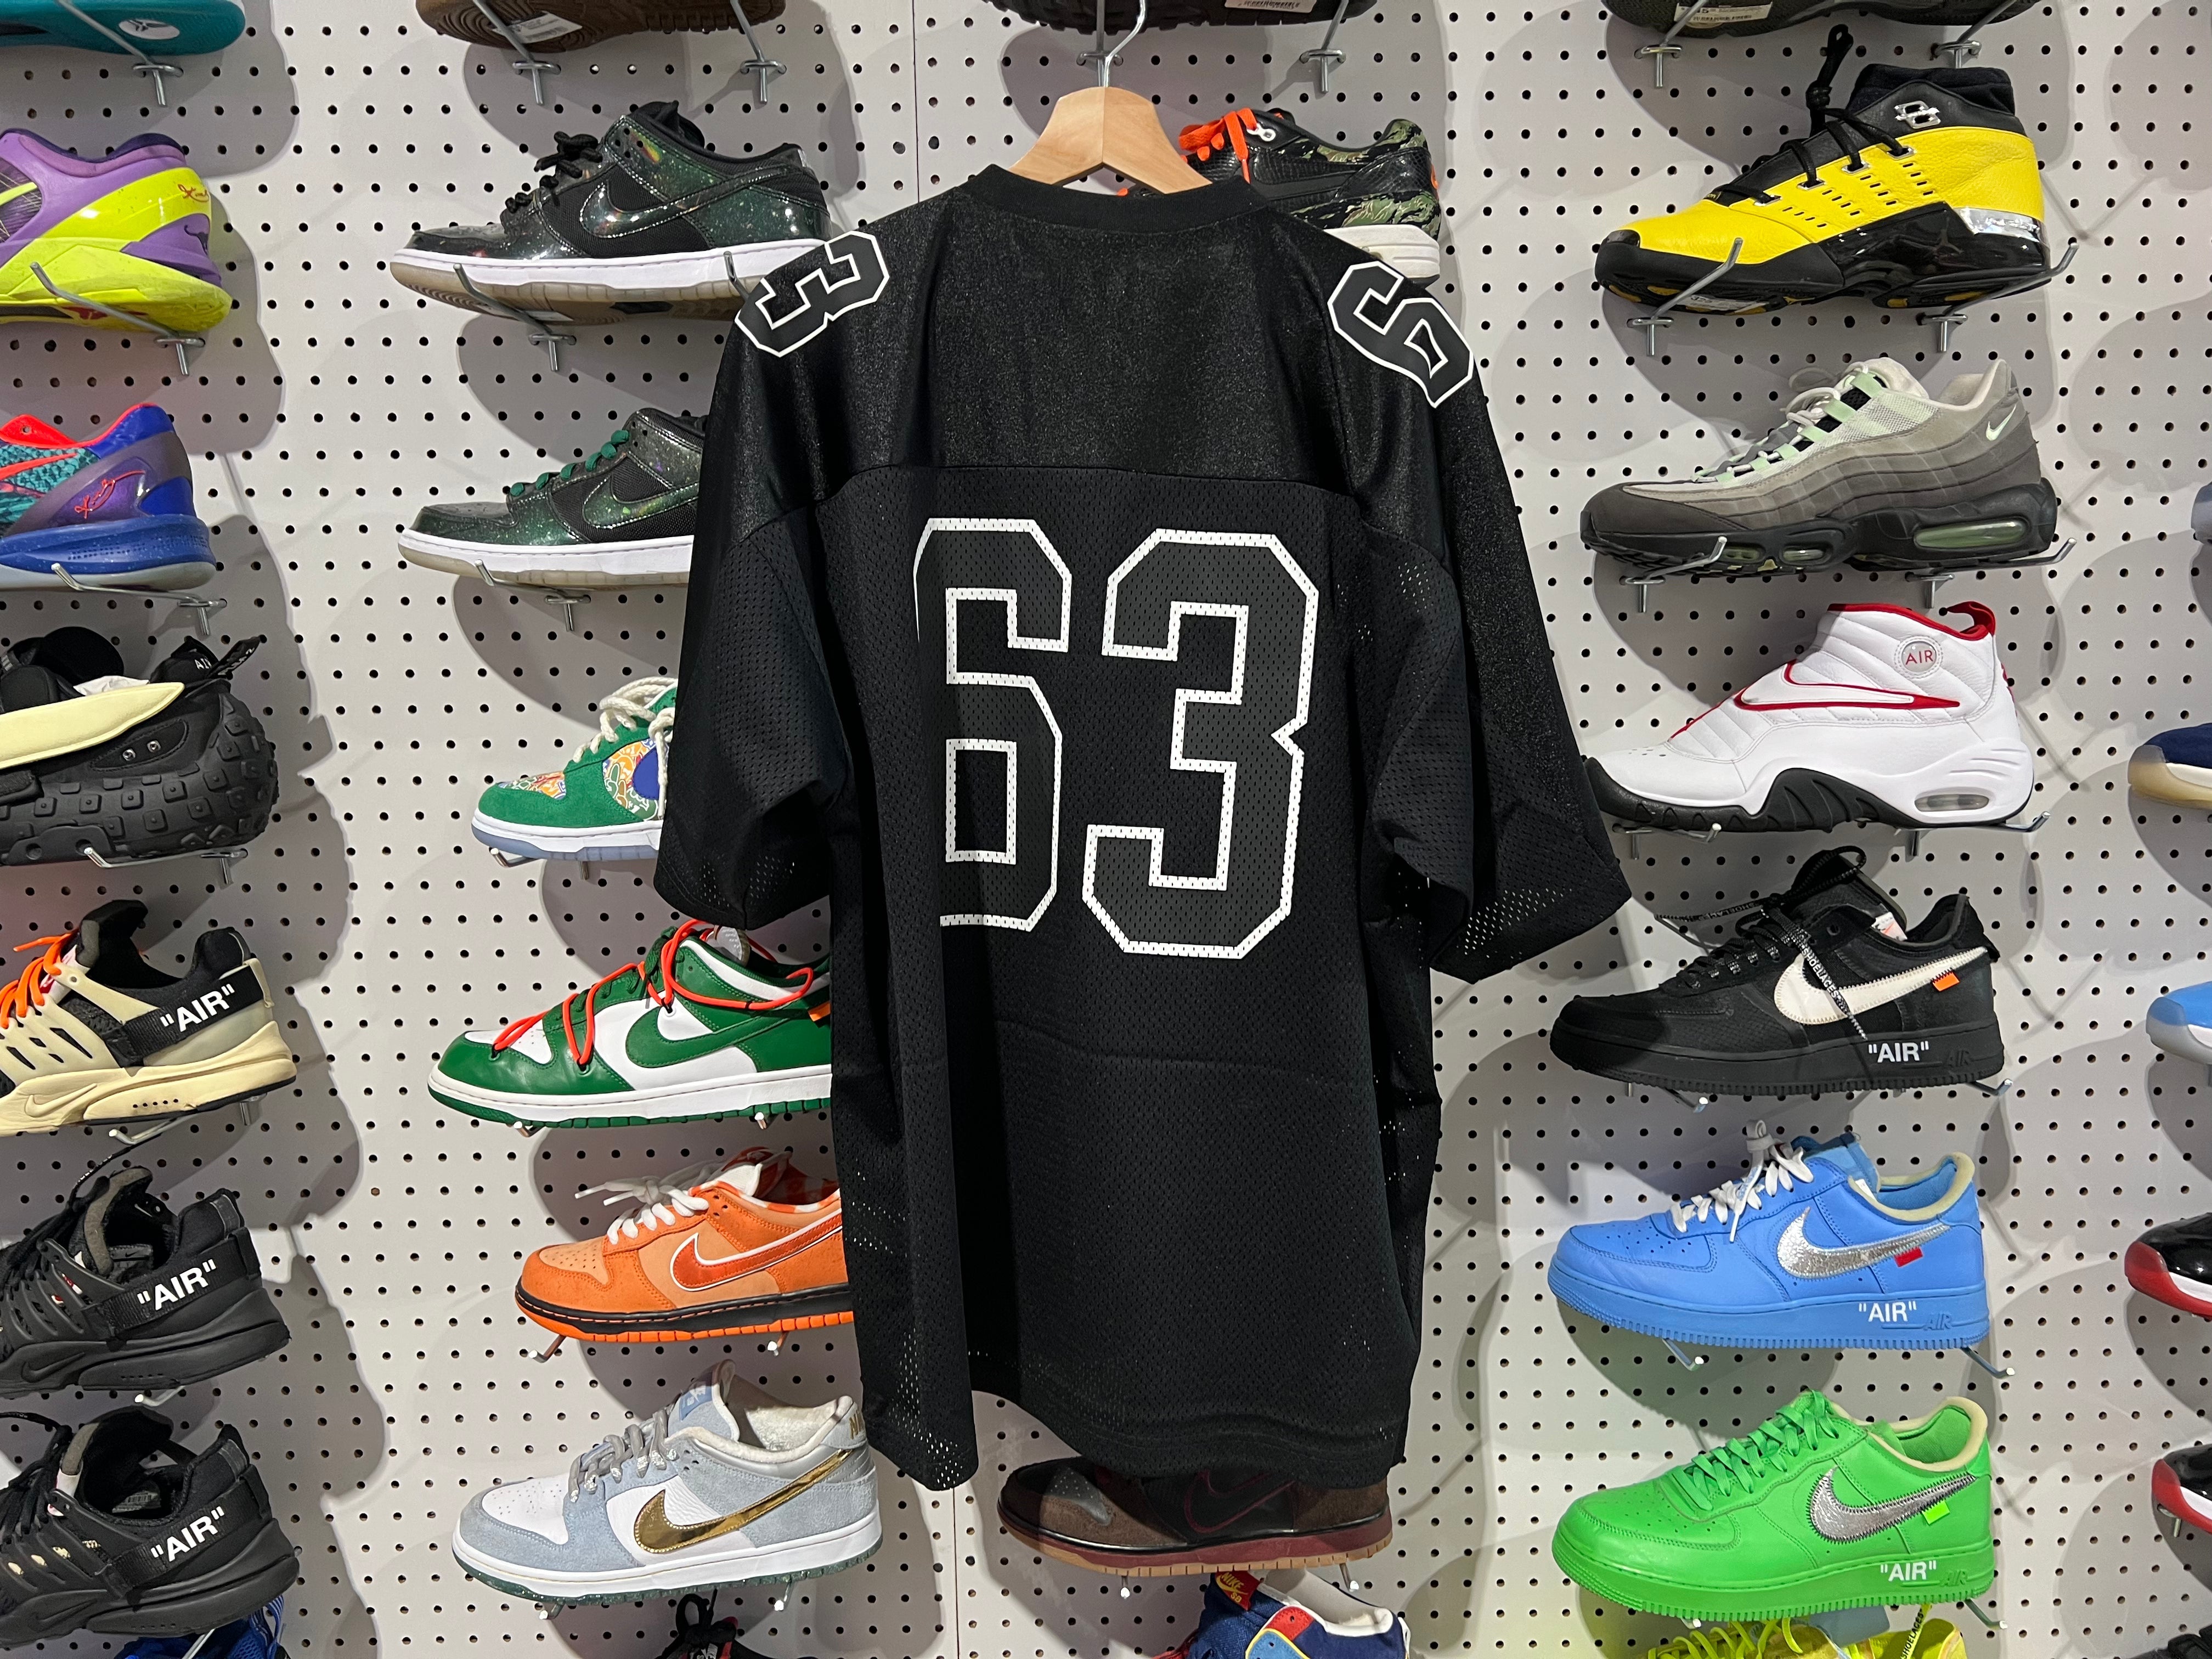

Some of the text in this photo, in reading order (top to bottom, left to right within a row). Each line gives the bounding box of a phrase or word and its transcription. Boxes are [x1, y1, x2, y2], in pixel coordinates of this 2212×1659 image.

[734, 230, 890, 358] 3
[1327, 261, 1474, 409] 6
[1905, 650, 1934, 665] AIR
[913, 517, 1319, 960] 63
[160, 983, 235, 1032] "AIR"
[1868, 1040, 1929, 1063] "AIR"
[137, 1259, 217, 1311] "AIR"
[1858, 1300, 1917, 1323] "AIR"
[1923, 1312, 1953, 1331] AIR
[150, 1506, 225, 1562] "AIR"
[1221, 1572, 1245, 1589] NIKE
[1880, 1560, 1937, 1582] "AIR"
[1940, 1569, 1968, 1587] AIR
[1230, 1592, 1243, 1603] SB
